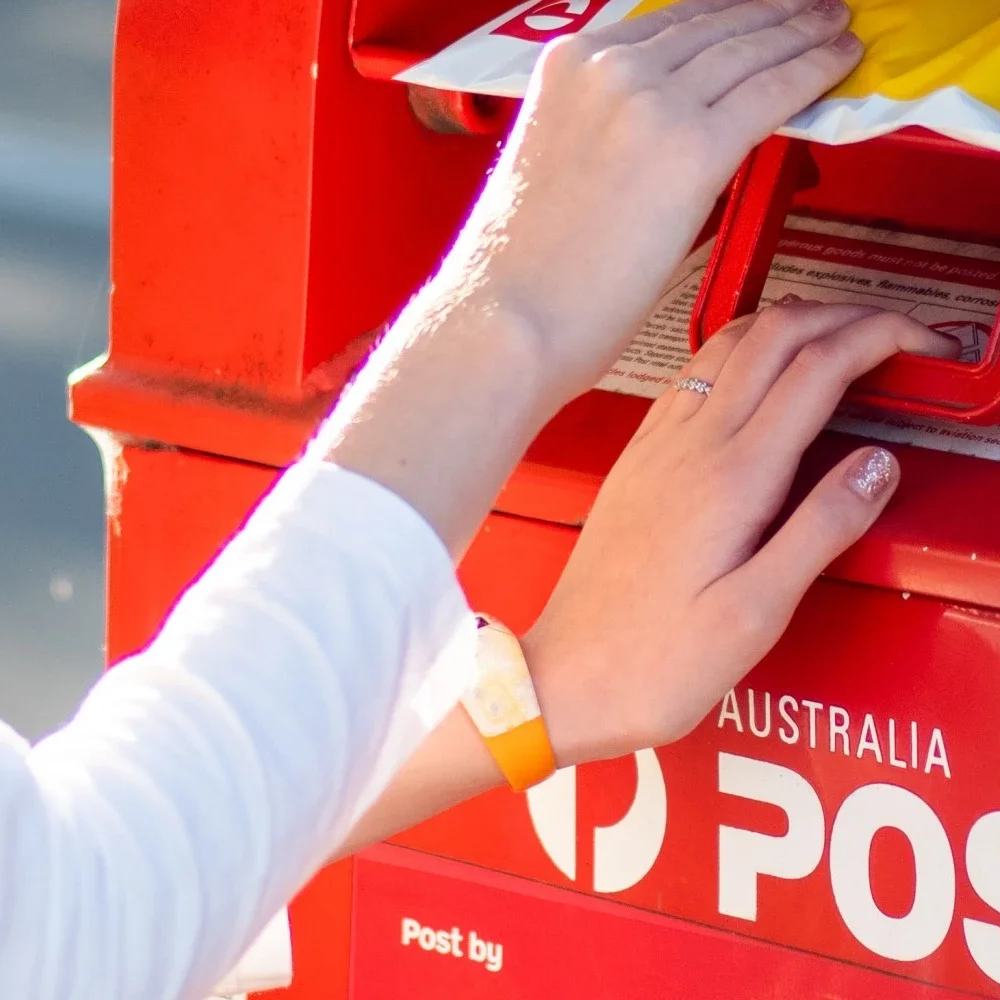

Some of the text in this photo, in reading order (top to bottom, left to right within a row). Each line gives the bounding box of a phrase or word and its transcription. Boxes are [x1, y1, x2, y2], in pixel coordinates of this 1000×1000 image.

[776, 238, 1000, 281] gerous goods must not be posted.
[771, 263, 805, 276] ludes
[806, 270, 873, 288] explosives,
[875, 279, 952, 300] flammables,
[626, 370, 663, 384] lodged
[884, 419, 925, 432] subject
[925, 425, 938, 434] to
[938, 428, 984, 442] aviation
[717, 689, 951, 779] AUSTRALIA
[400, 916, 503, 973] Post by
